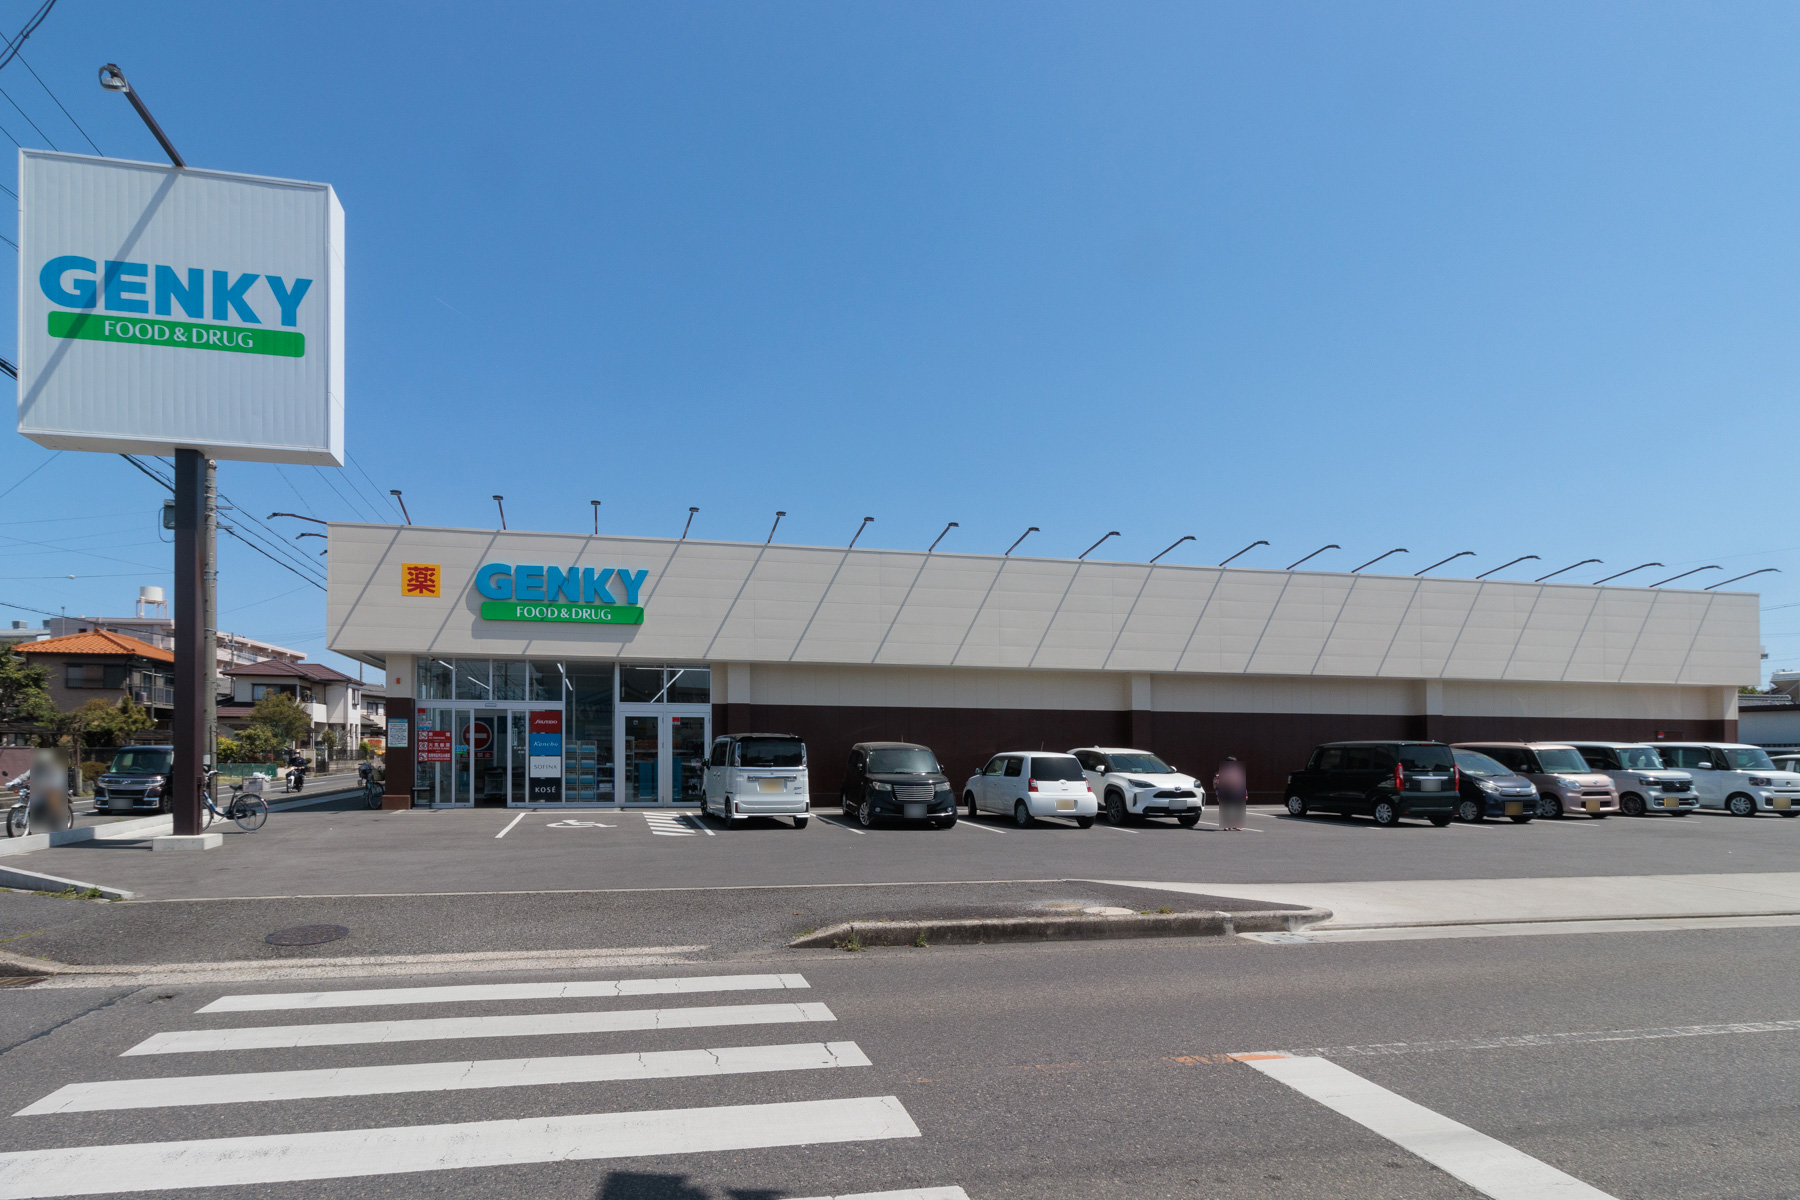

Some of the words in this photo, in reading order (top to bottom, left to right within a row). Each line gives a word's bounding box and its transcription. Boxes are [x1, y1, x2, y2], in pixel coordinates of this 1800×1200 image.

[39, 255, 313, 327] GENKY
[104, 320, 168, 341] FOOD
[173, 328, 189, 343] &
[191, 327, 254, 348] DRUG
[406, 566, 436, 594] 薬
[475, 563, 649, 604] GENKY
[516, 606, 558, 619] FOOD
[560, 607, 570, 619] &
[571, 607, 612, 620] DRUG
[534, 785, 557, 793] KOSÉ
